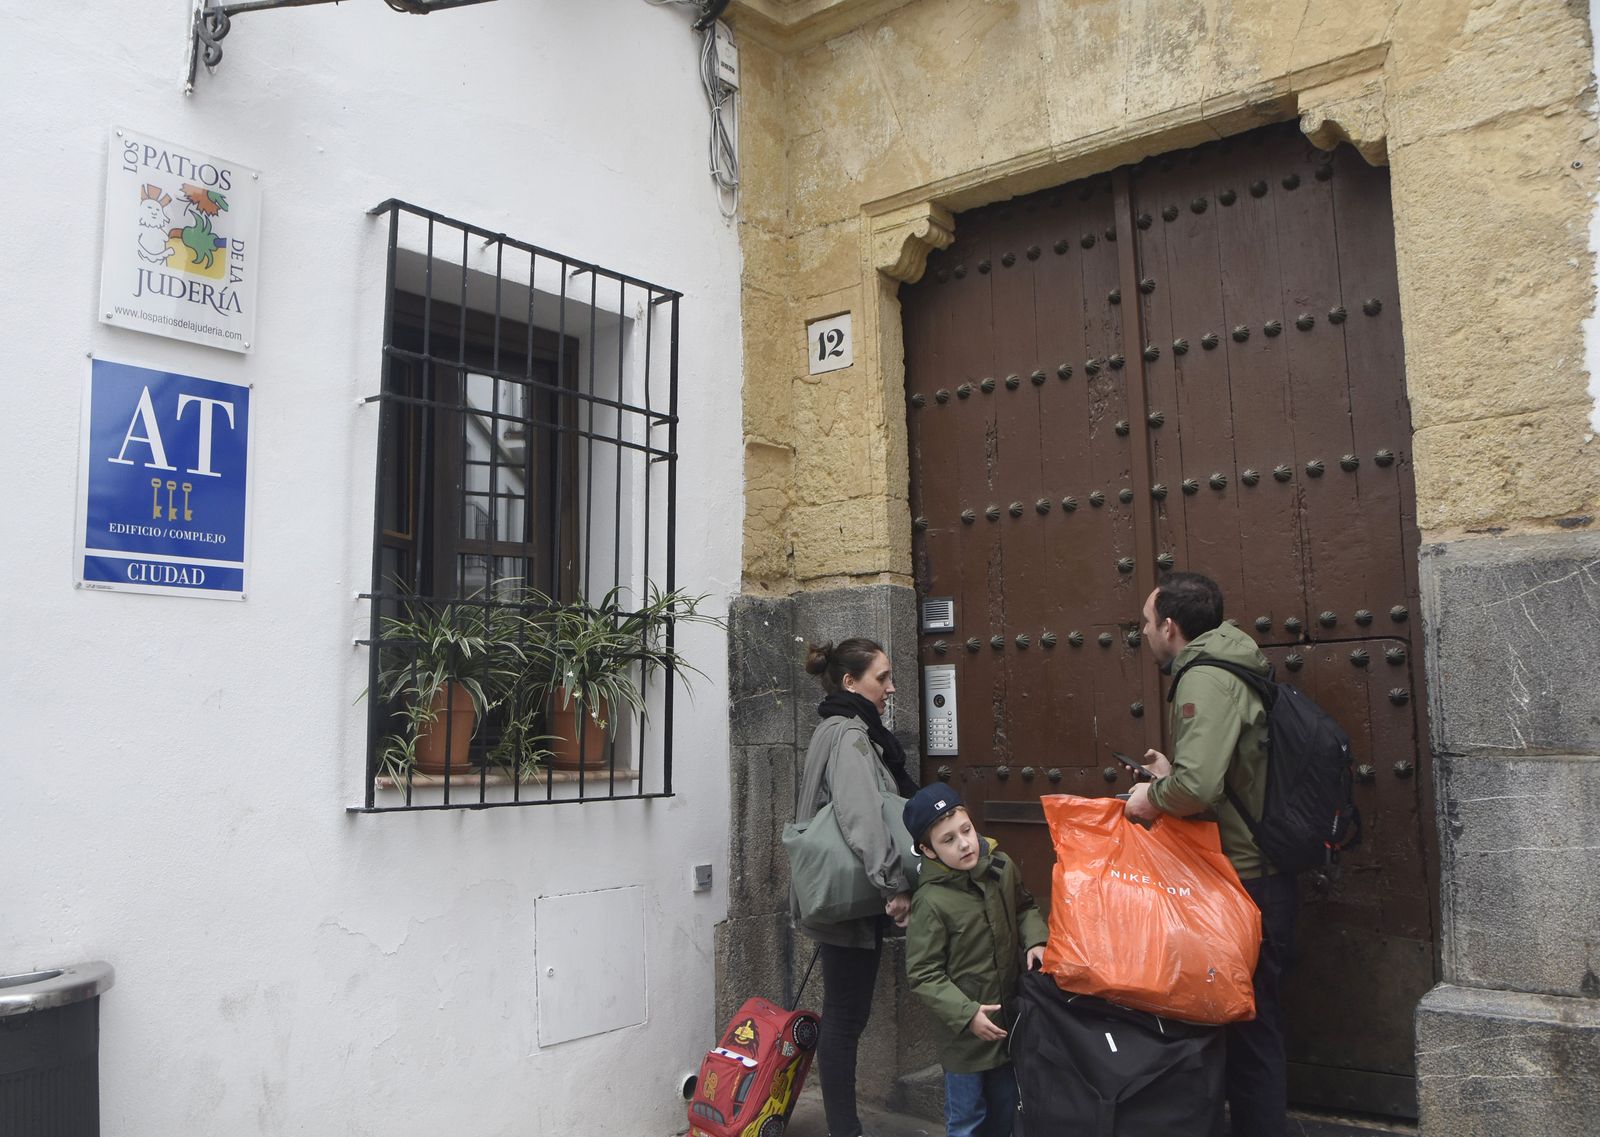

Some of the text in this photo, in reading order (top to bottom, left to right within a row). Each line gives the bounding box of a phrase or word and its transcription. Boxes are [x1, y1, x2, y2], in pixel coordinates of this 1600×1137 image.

[123, 140, 231, 190] LOS PATIOS
[230, 238, 244, 283] DE LA
[133, 267, 243, 316] JUDERÍA
[114, 304, 242, 341] www.lospatiosdelajuderia.com
[818, 328, 844, 361] 12
[108, 385, 235, 478] AT
[109, 522, 162, 537] EDIFICIO
[169, 529, 226, 544] COMPLEJO
[127, 562, 205, 585] CIUDAD
